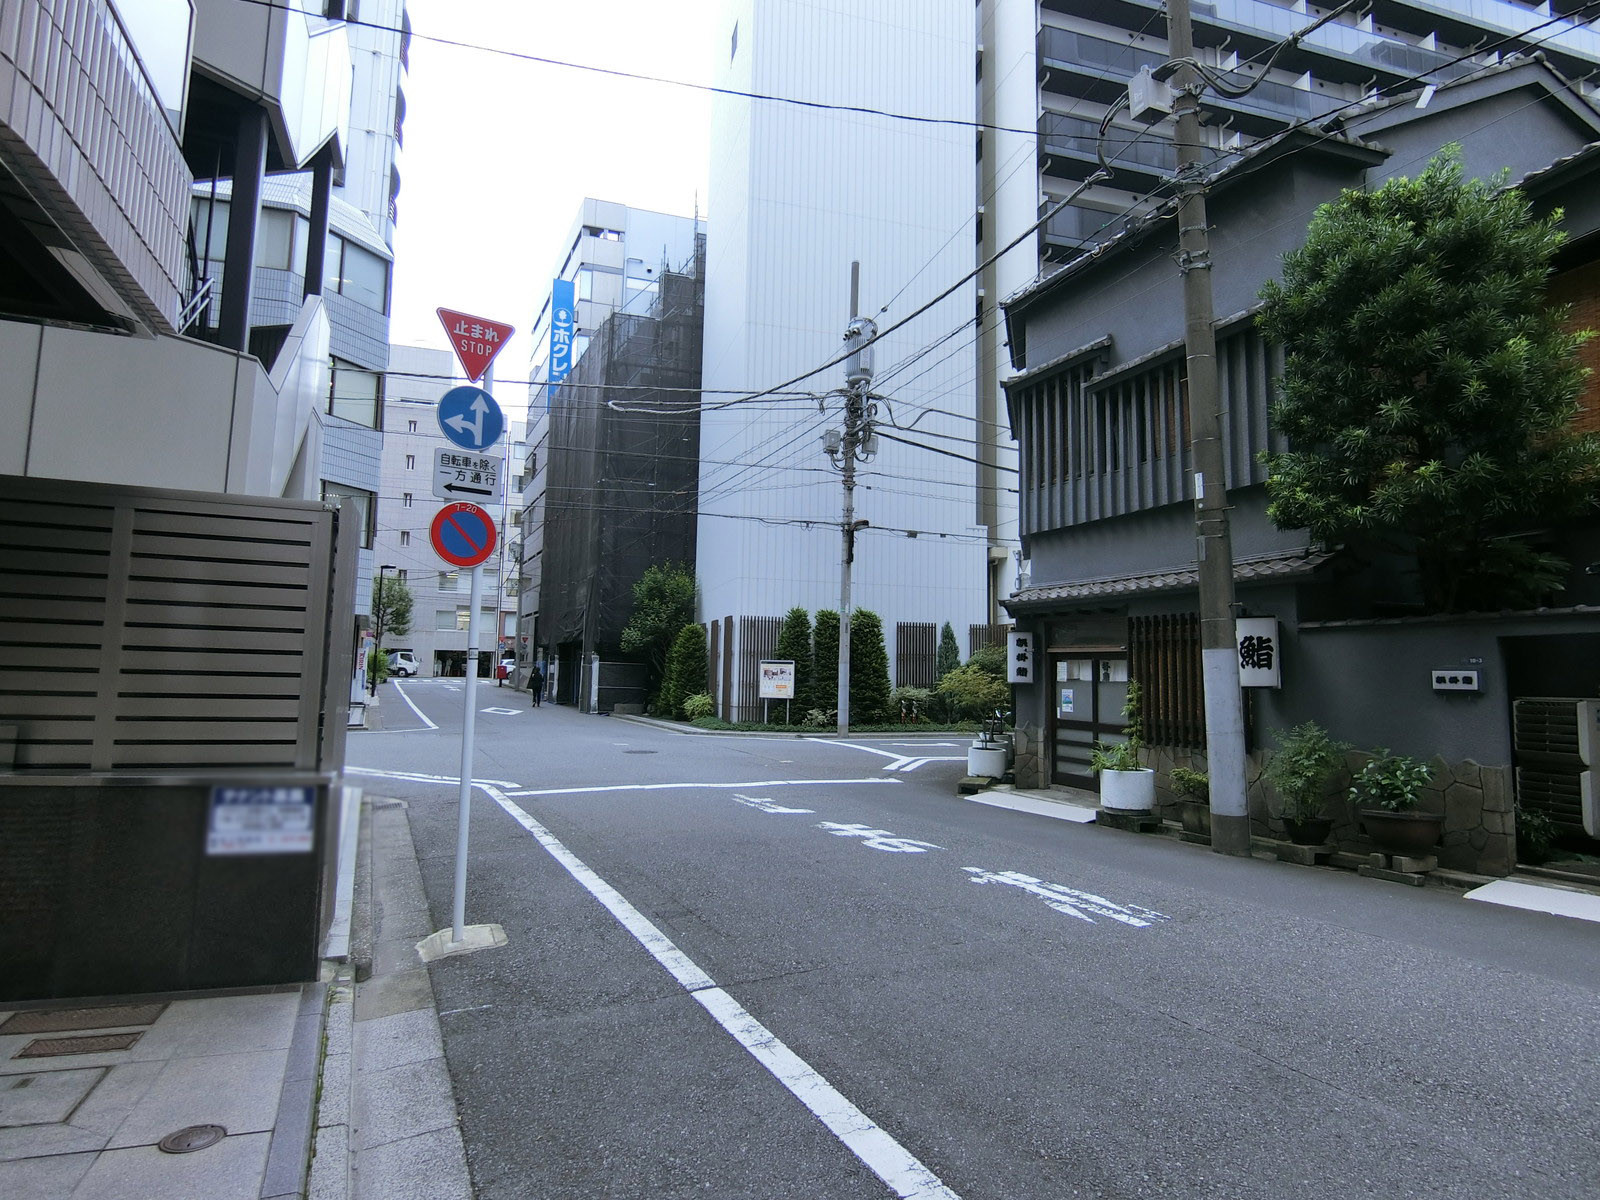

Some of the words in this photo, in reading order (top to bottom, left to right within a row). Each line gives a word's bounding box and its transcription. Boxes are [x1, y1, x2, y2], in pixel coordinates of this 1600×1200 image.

[454, 320, 499, 342] 止まれ
[461, 340, 492, 356] STOP
[441, 453, 496, 472] 自転車を除く
[440, 470, 496, 486] 一方通行
[455, 503, 478, 514] 7-20
[1239, 636, 1274, 670] 鮨
